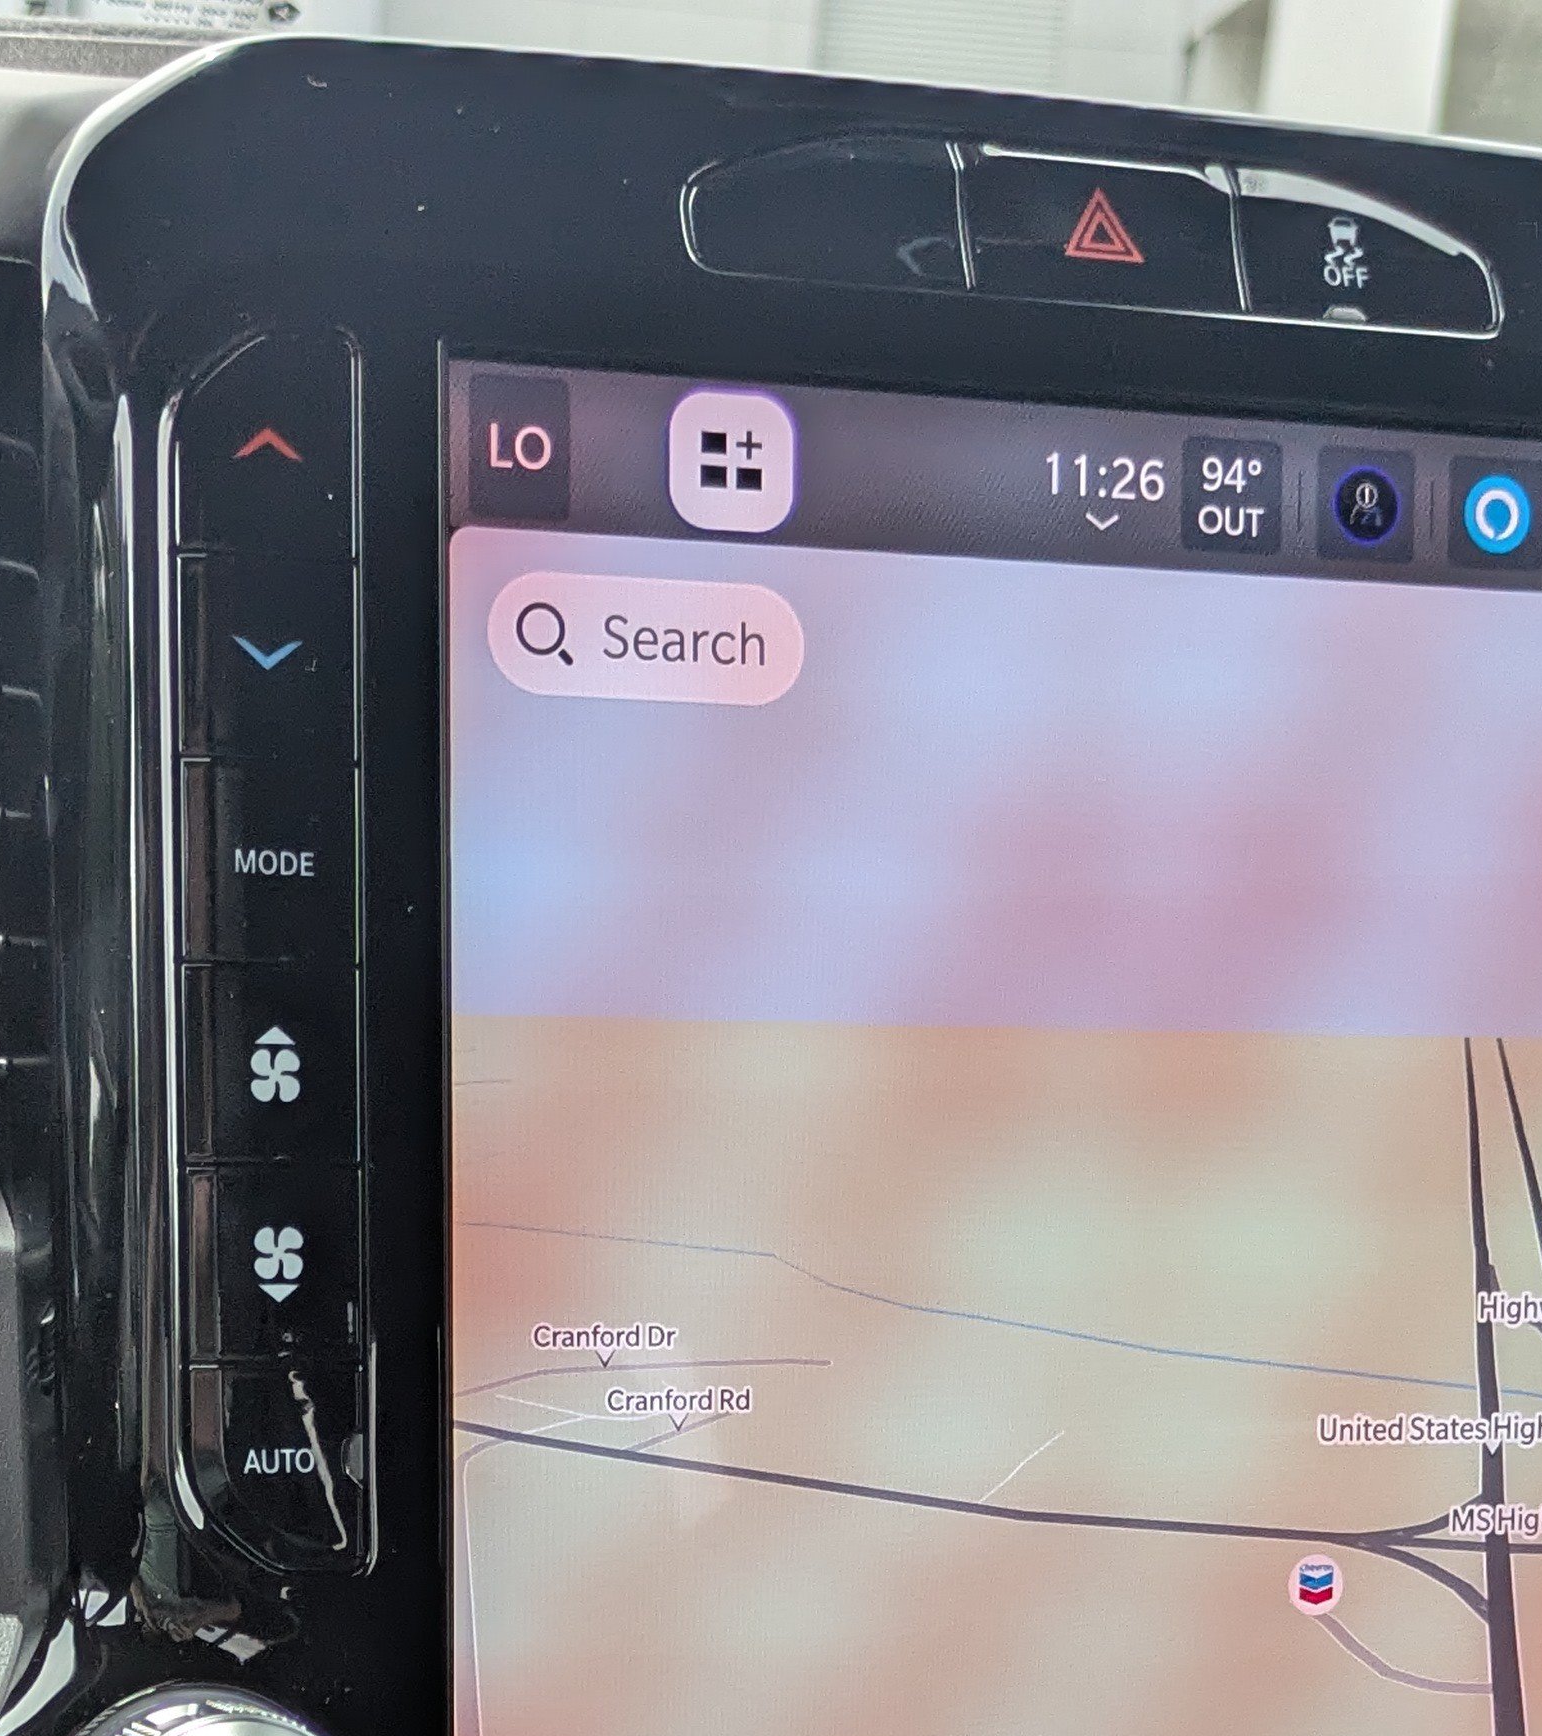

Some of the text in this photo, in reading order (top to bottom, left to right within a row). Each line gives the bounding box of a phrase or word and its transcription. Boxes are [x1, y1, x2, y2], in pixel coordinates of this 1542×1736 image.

[1323, 265, 1369, 288] OFF
[488, 422, 552, 471] LO
[1045, 452, 1165, 502] 11:26
[1201, 456, 1263, 495] 94°
[1198, 505, 1264, 538] OUT
[603, 614, 766, 666] Search
[234, 848, 315, 876] MODE
[533, 1324, 677, 1349] Cranford Dr
[607, 1387, 751, 1413] Cranford Rd
[1319, 1417, 1403, 1442] United
[1410, 1416, 1487, 1441] States
[243, 1448, 315, 1475] AUTO
[1451, 1509, 1492, 1533] MS
